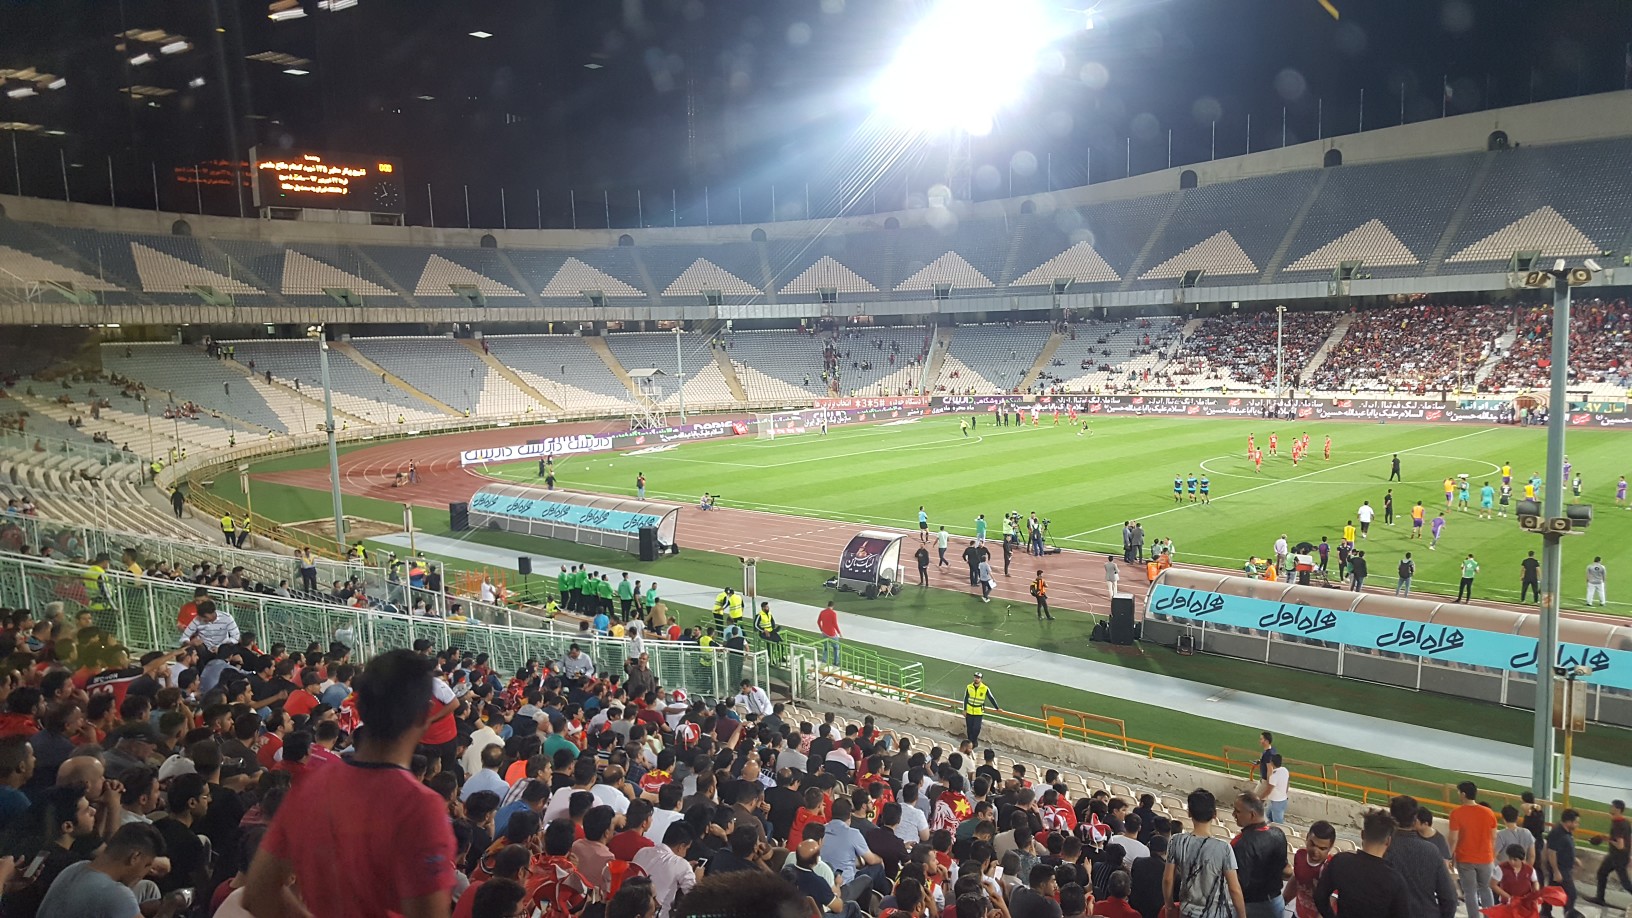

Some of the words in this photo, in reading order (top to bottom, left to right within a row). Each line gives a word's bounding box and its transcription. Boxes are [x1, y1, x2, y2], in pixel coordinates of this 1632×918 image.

[1379, 409, 1399, 418] علیک
[1398, 409, 1424, 419] السلام
[1604, 402, 1624, 413] سال
[1155, 588, 1195, 610] اول
[1189, 593, 1225, 617] همراه
[1258, 604, 1303, 627] اول
[1298, 610, 1337, 634] همراه
[1376, 621, 1425, 647] اول
[1419, 627, 1464, 655] همراه
